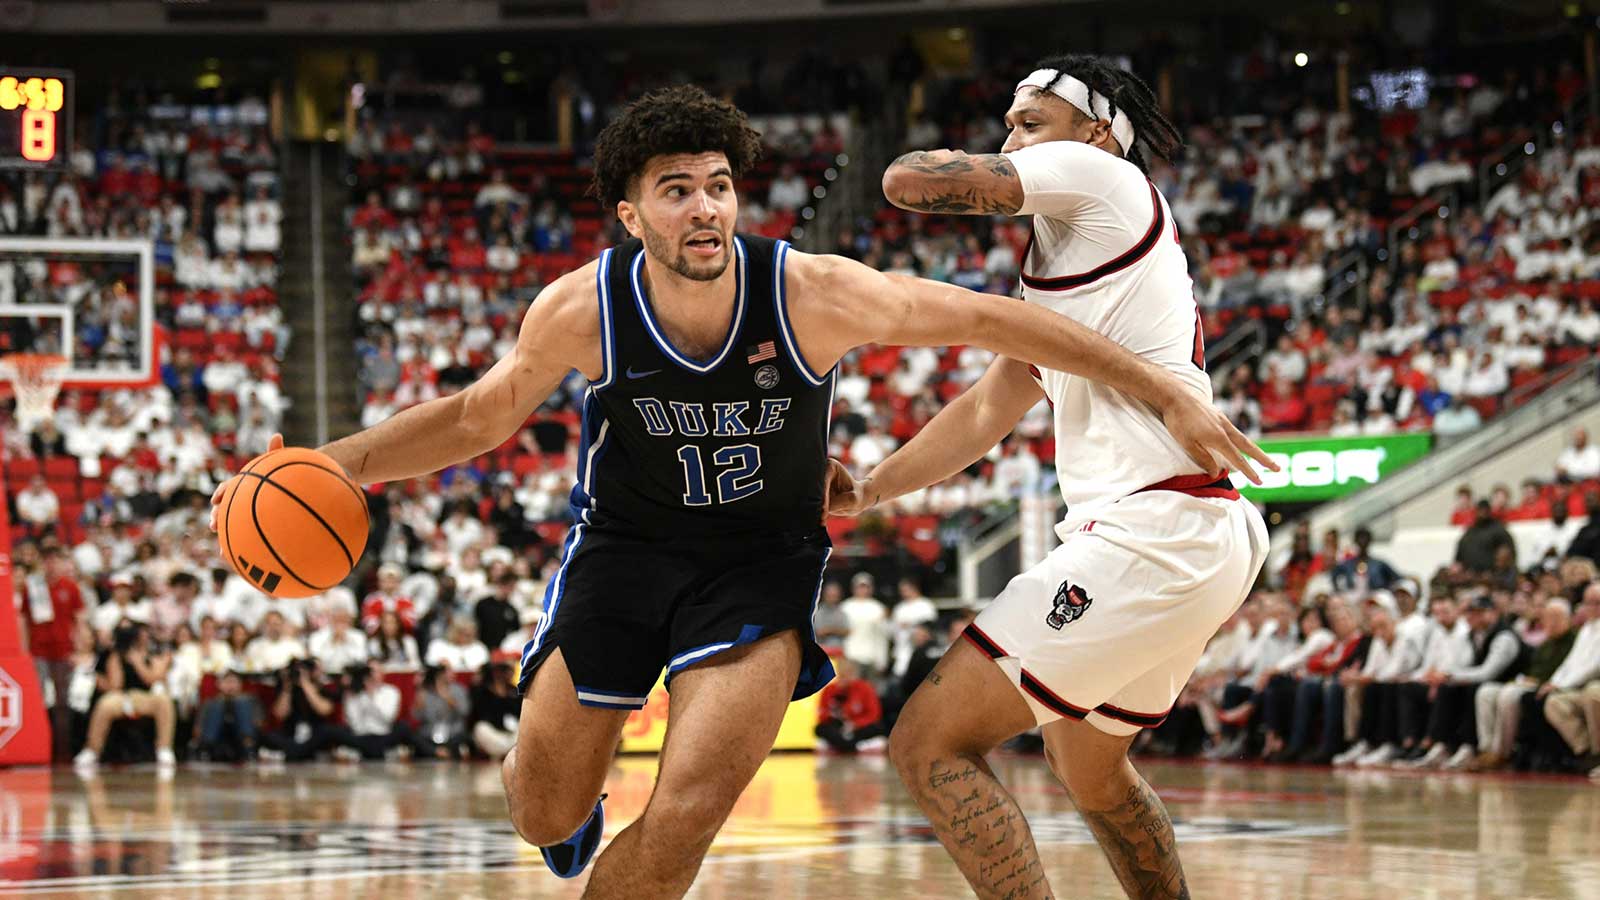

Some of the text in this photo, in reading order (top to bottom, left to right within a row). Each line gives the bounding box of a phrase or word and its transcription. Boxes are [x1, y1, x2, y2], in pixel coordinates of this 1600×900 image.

[22, 109, 55, 161] 8
[633, 398, 791, 436] DUKE
[677, 443, 763, 506] 12
